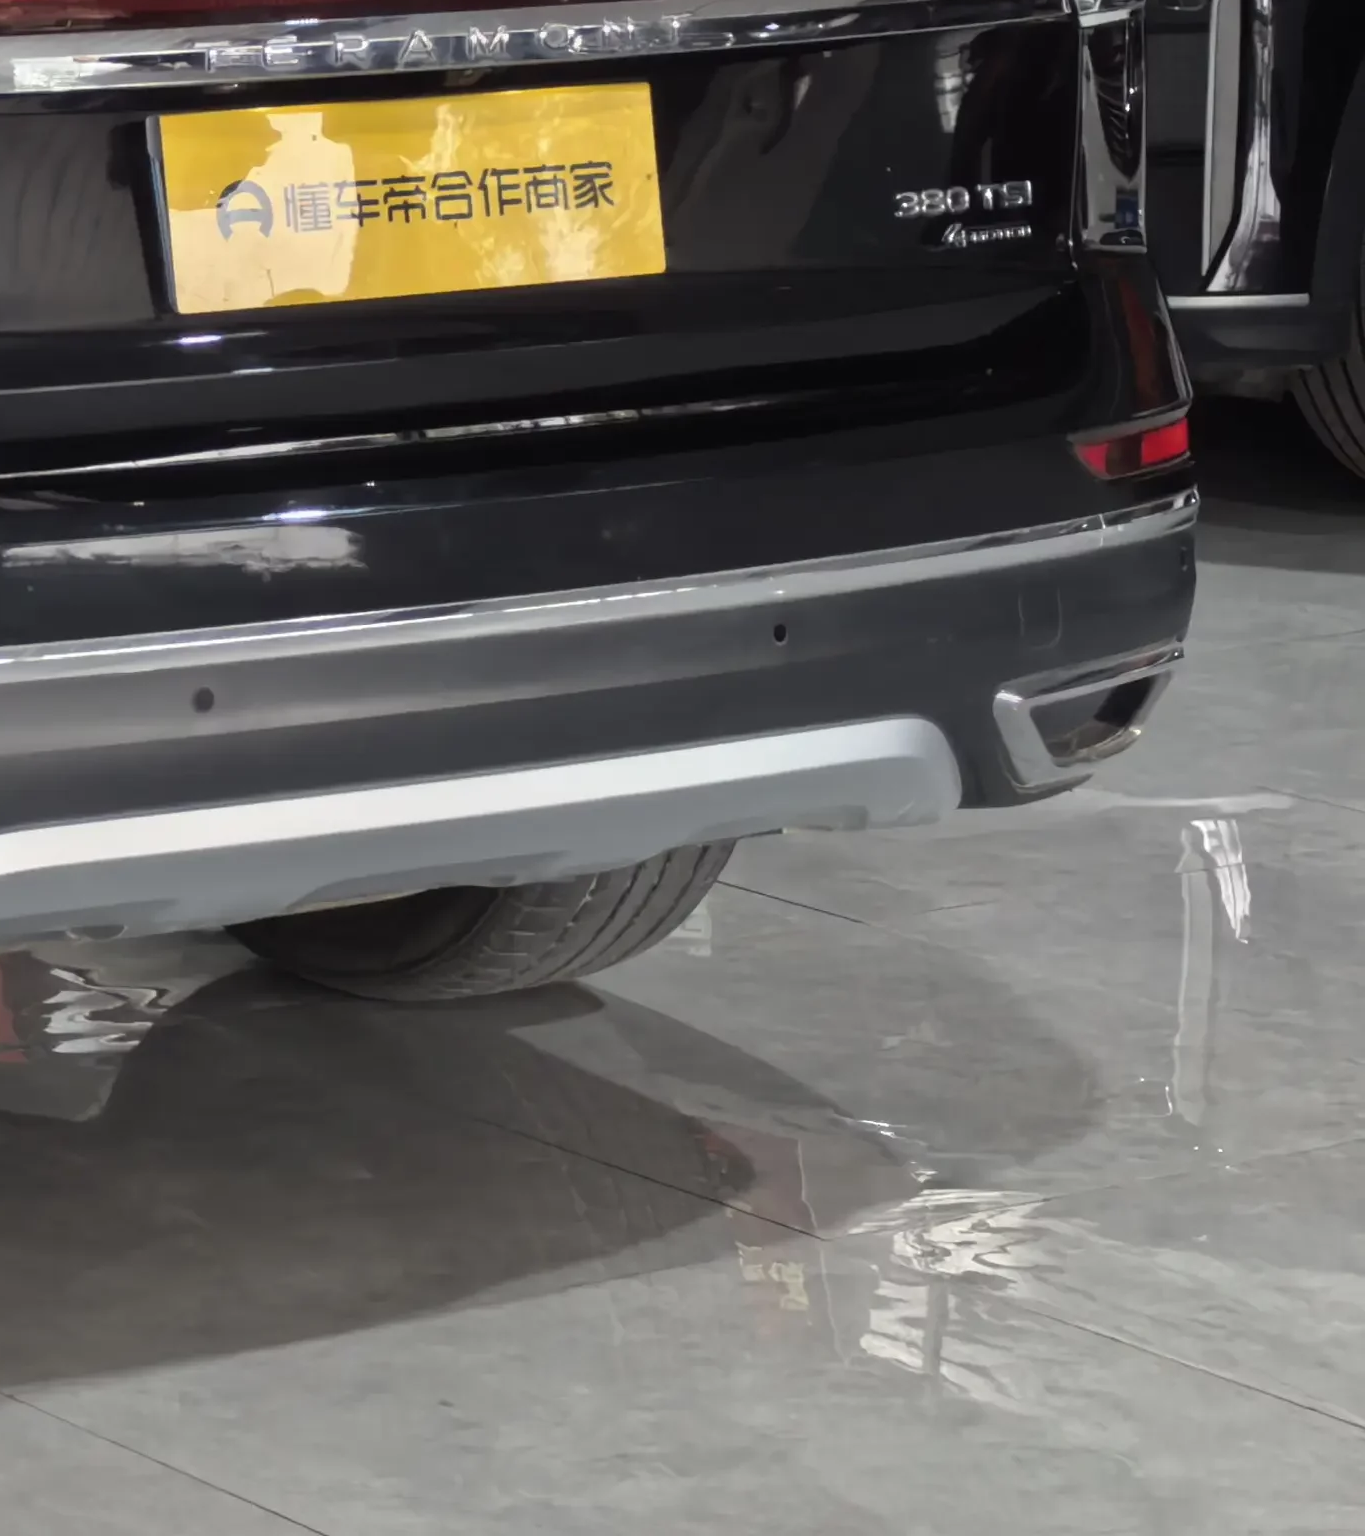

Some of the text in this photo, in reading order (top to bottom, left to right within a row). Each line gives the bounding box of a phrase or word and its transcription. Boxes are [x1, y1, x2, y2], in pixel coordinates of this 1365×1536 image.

[188, 11, 696, 73] TERAMONT
[282, 160, 616, 233] 懂车帝合作商家
[894, 179, 1032, 217] 380 TSI
